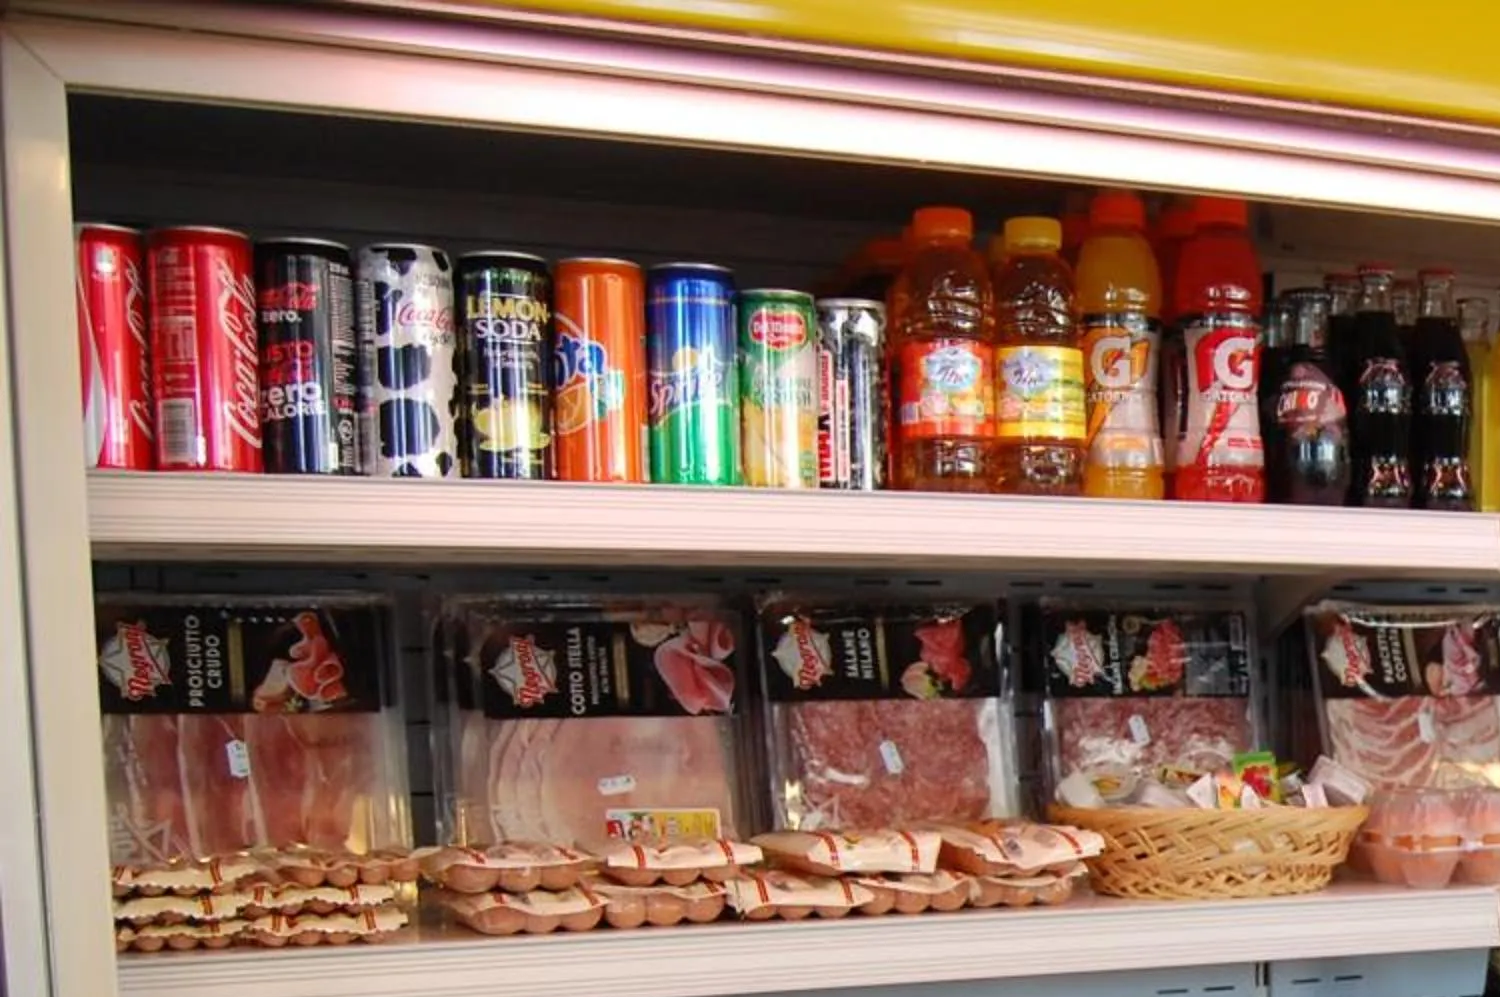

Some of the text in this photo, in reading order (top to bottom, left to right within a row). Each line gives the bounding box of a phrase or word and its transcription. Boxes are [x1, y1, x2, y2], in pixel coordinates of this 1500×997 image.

[475, 319, 541, 341] SODA
[1213, 337, 1256, 389] G
[184, 615, 204, 708] PROSCIUTTO
[207, 635, 222, 690] CRUDO
[569, 666, 587, 716] COTTO
